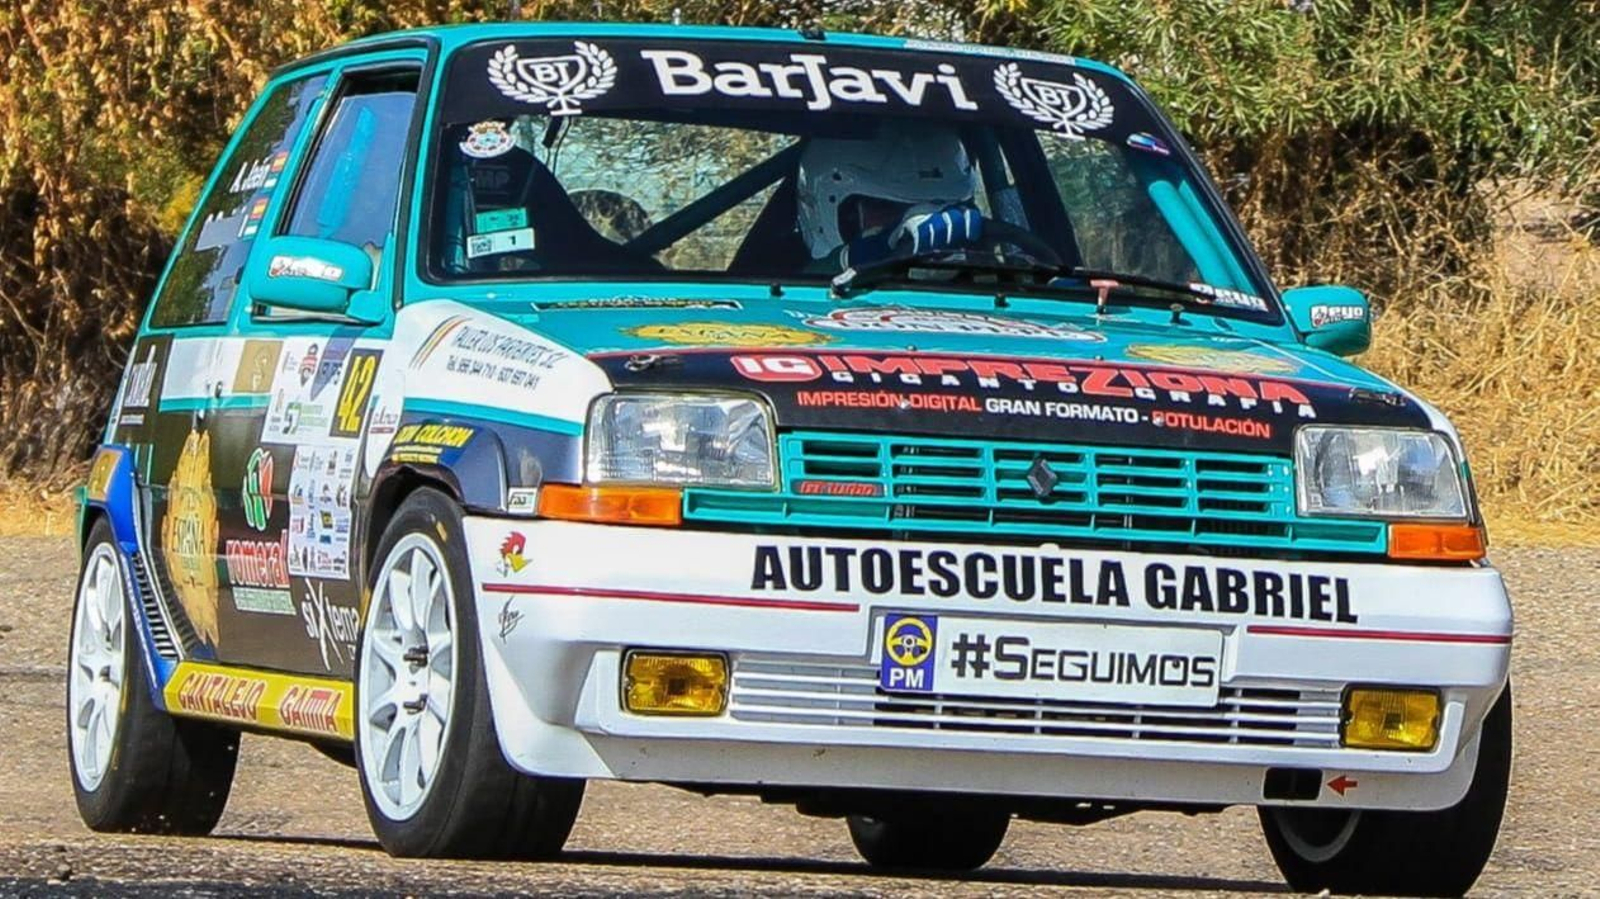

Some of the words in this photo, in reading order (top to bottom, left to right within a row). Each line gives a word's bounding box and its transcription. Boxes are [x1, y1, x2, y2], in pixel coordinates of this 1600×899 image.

[533, 63, 570, 85] BJ
[640, 49, 979, 112] BarJavi
[1033, 86, 1076, 113] BJ
[337, 355, 377, 433] 42
[817, 354, 1313, 406] IMPREZIONA
[796, 389, 904, 410] IMPRESIÓN
[909, 392, 983, 414] DIGITAL
[984, 398, 1041, 416] GRAN
[1045, 402, 1139, 424] FORMATO
[225, 528, 291, 589] romeral
[750, 544, 1130, 608] AUTOESCUELA
[1143, 561, 1359, 624] GABRIEL
[888, 668, 925, 690] PM
